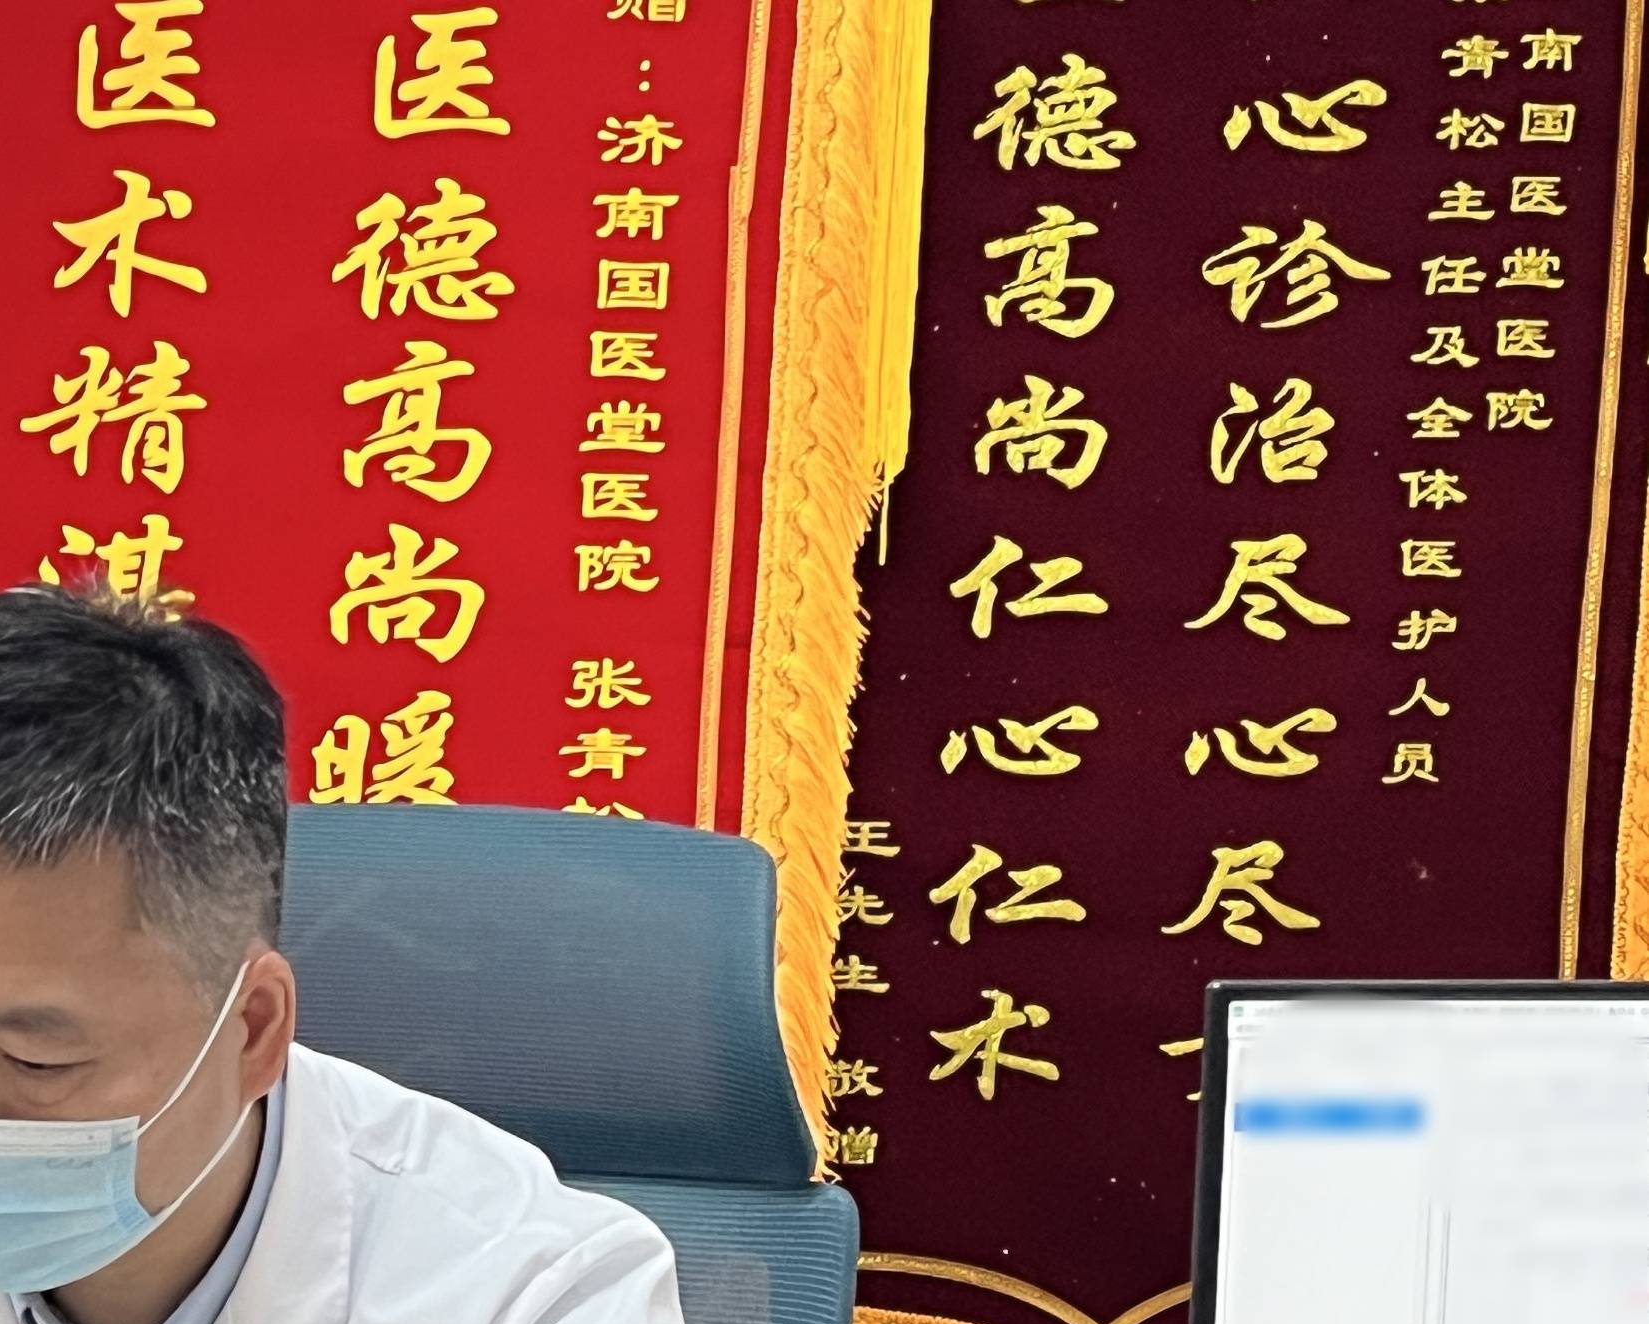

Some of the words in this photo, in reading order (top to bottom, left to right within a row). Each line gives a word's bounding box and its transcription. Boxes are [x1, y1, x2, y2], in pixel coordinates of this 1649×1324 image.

[308, 6, 517, 808] 医德高尚暖
[928, 0, 1138, 1101] 德高尚仁心仁术
[1157, 79, 1392, 1101] 心诊治尽心尽
[1381, 0, 1510, 785] 青松主任及全体医护人员
[1486, 27, 1583, 432] 南国医堂医院
[558, 657, 652, 820] 张青
